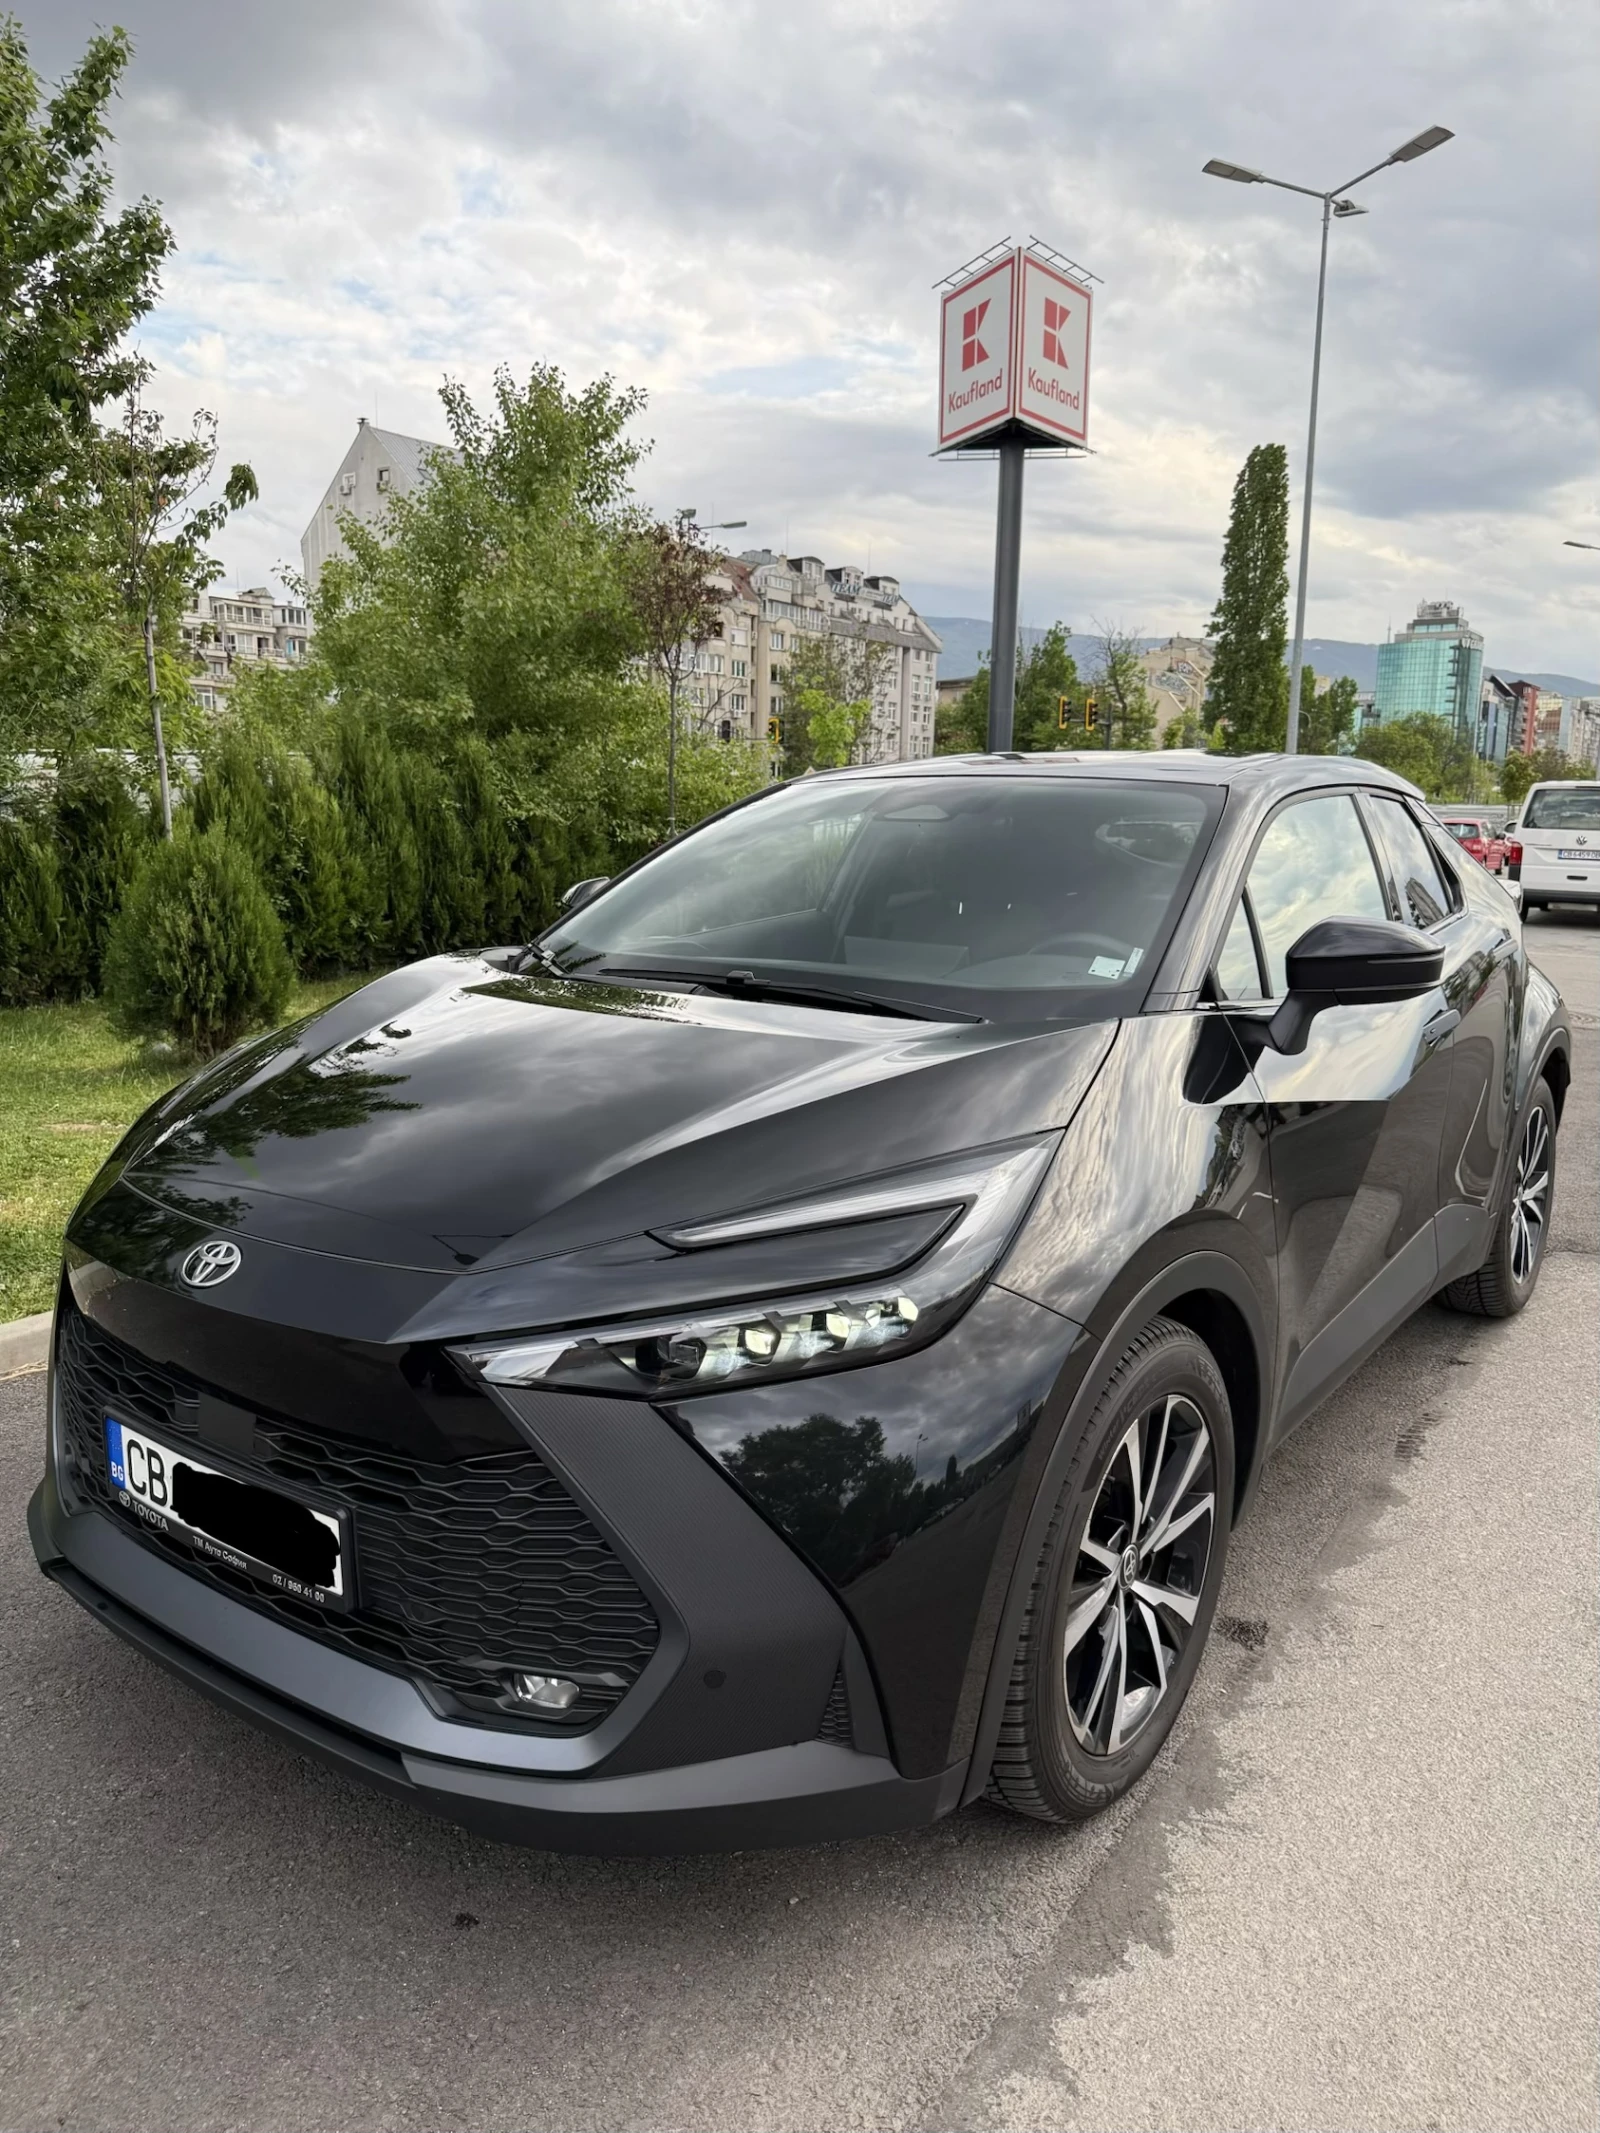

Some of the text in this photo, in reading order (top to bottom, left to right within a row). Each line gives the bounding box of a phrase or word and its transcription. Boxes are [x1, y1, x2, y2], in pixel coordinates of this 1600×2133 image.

[948, 368, 1003, 414] Kaufland
[1028, 367, 1080, 410] Kaufland
[111, 1461, 125, 1482] BG
[127, 1439, 168, 1507] CB
[132, 1500, 169, 1531] TOYOTA
[222, 1550, 247, 1570] София
[272, 1574, 282, 1586] 02
[303, 1587, 312, 1598] 41
